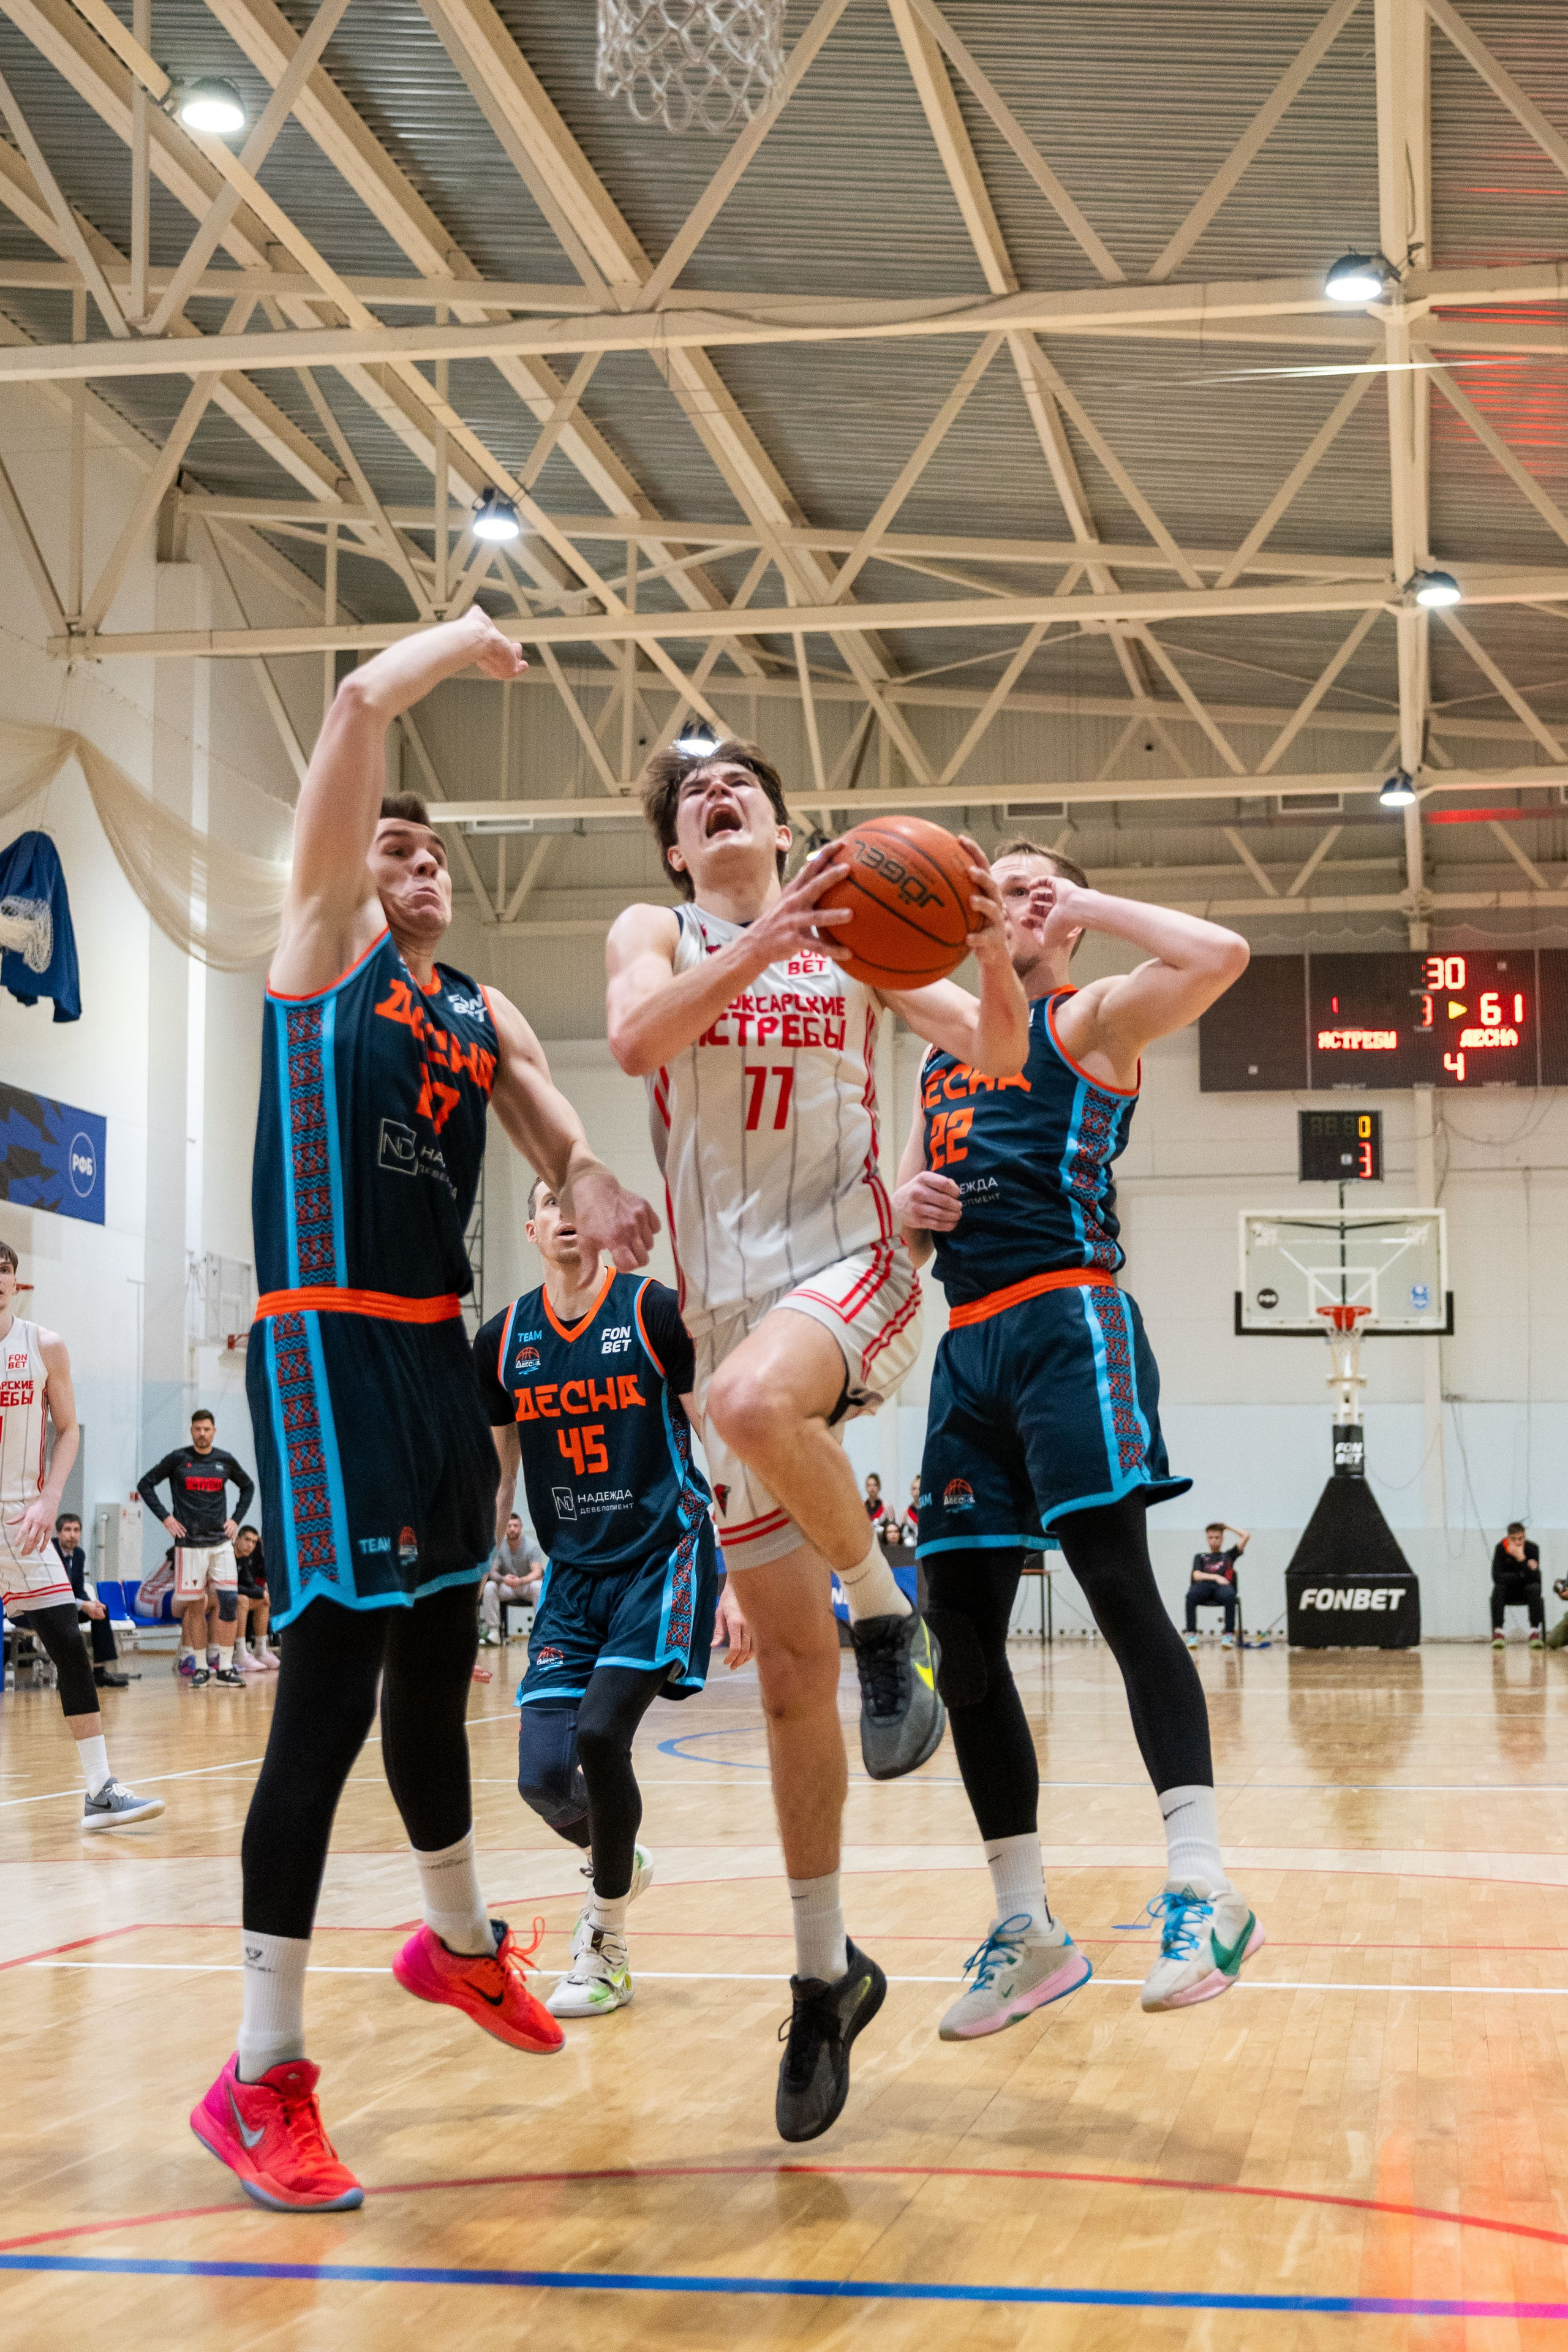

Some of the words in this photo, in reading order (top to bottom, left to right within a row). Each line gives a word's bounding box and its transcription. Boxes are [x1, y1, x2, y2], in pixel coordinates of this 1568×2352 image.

[854, 840, 944, 908] JÖGEL
[788, 960, 826, 975] BET
[1480, 992, 1524, 1026] 61
[1443, 1052, 1466, 1081] 4
[921, 1063, 1032, 1112] ЕСНА
[1358, 1115, 1371, 1138] 0
[929, 1107, 976, 1172] 22
[1359, 1141, 1373, 1178] 3
[518, 1330, 543, 1343] TEAM
[601, 1325, 631, 1341] FON
[601, 1339, 632, 1354] BET
[514, 1374, 646, 1422] ДЕСНА
[557, 1424, 609, 1476] 45
[1335, 1442, 1363, 1453] FON
[1335, 1452, 1363, 1464] BET
[578, 1489, 633, 1504] НАДЕЖДА
[1298, 1588, 1407, 1611] FONBET
